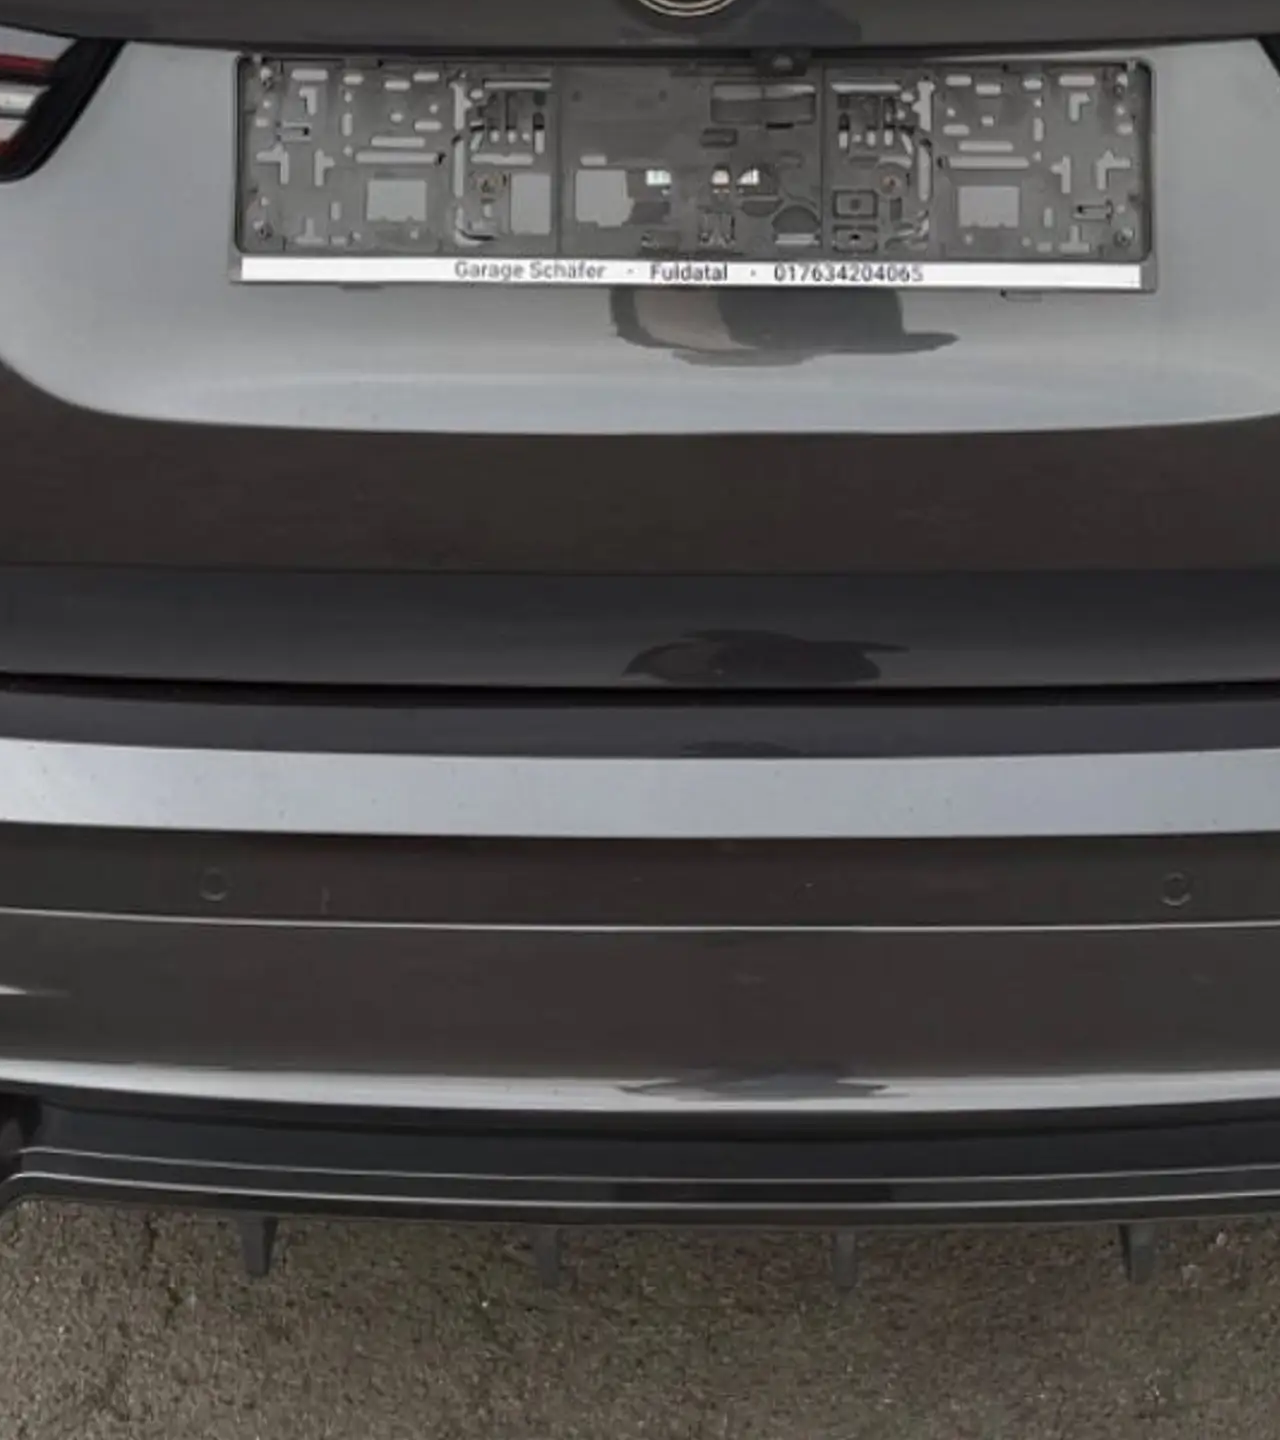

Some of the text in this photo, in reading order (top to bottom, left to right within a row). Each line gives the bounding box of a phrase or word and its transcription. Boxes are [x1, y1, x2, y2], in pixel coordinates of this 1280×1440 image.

[454, 260, 525, 280] Garage
[529, 260, 607, 279] Schäfer
[649, 262, 728, 281] Fuldatal
